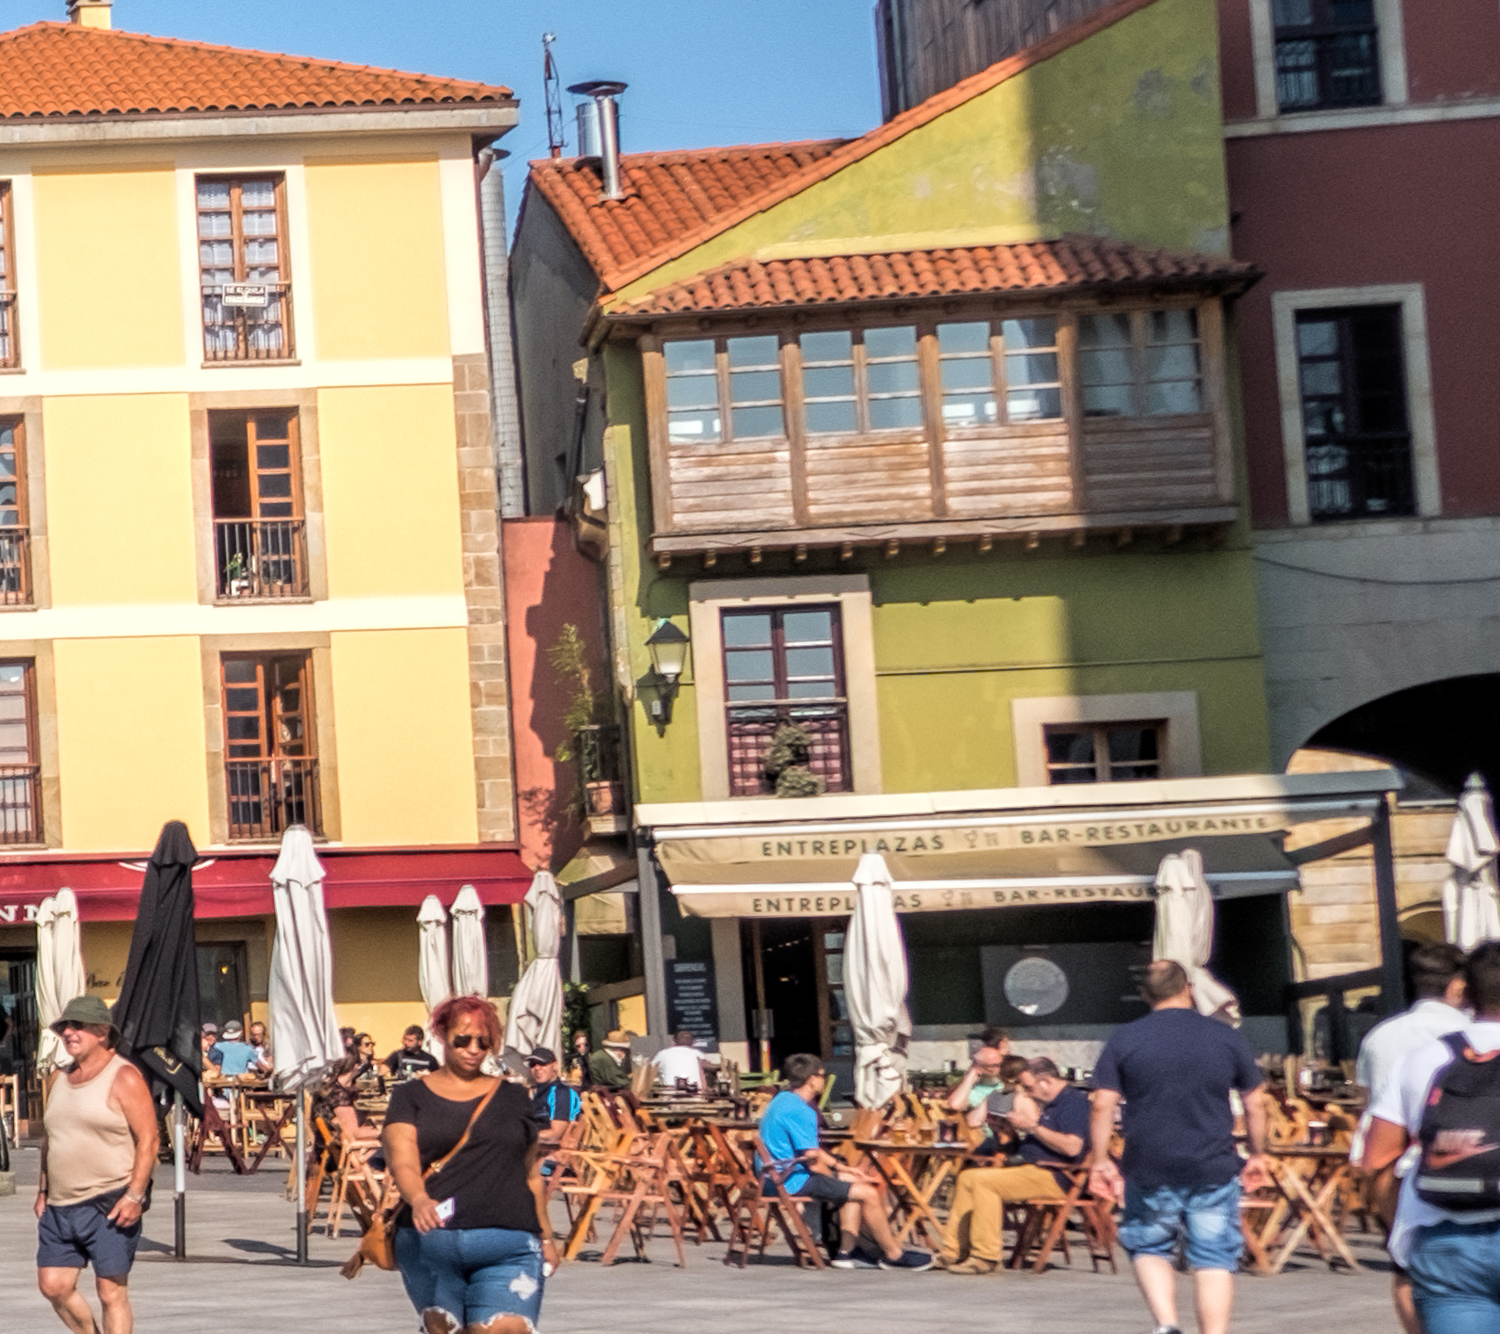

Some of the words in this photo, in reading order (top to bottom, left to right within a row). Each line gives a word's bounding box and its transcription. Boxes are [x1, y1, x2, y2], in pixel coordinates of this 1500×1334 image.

[762, 835, 945, 856] ENTREPLAZAS
[1020, 817, 1269, 845] BAR-RESTAURANTE
[753, 893, 921, 913] ENTREPLAS
